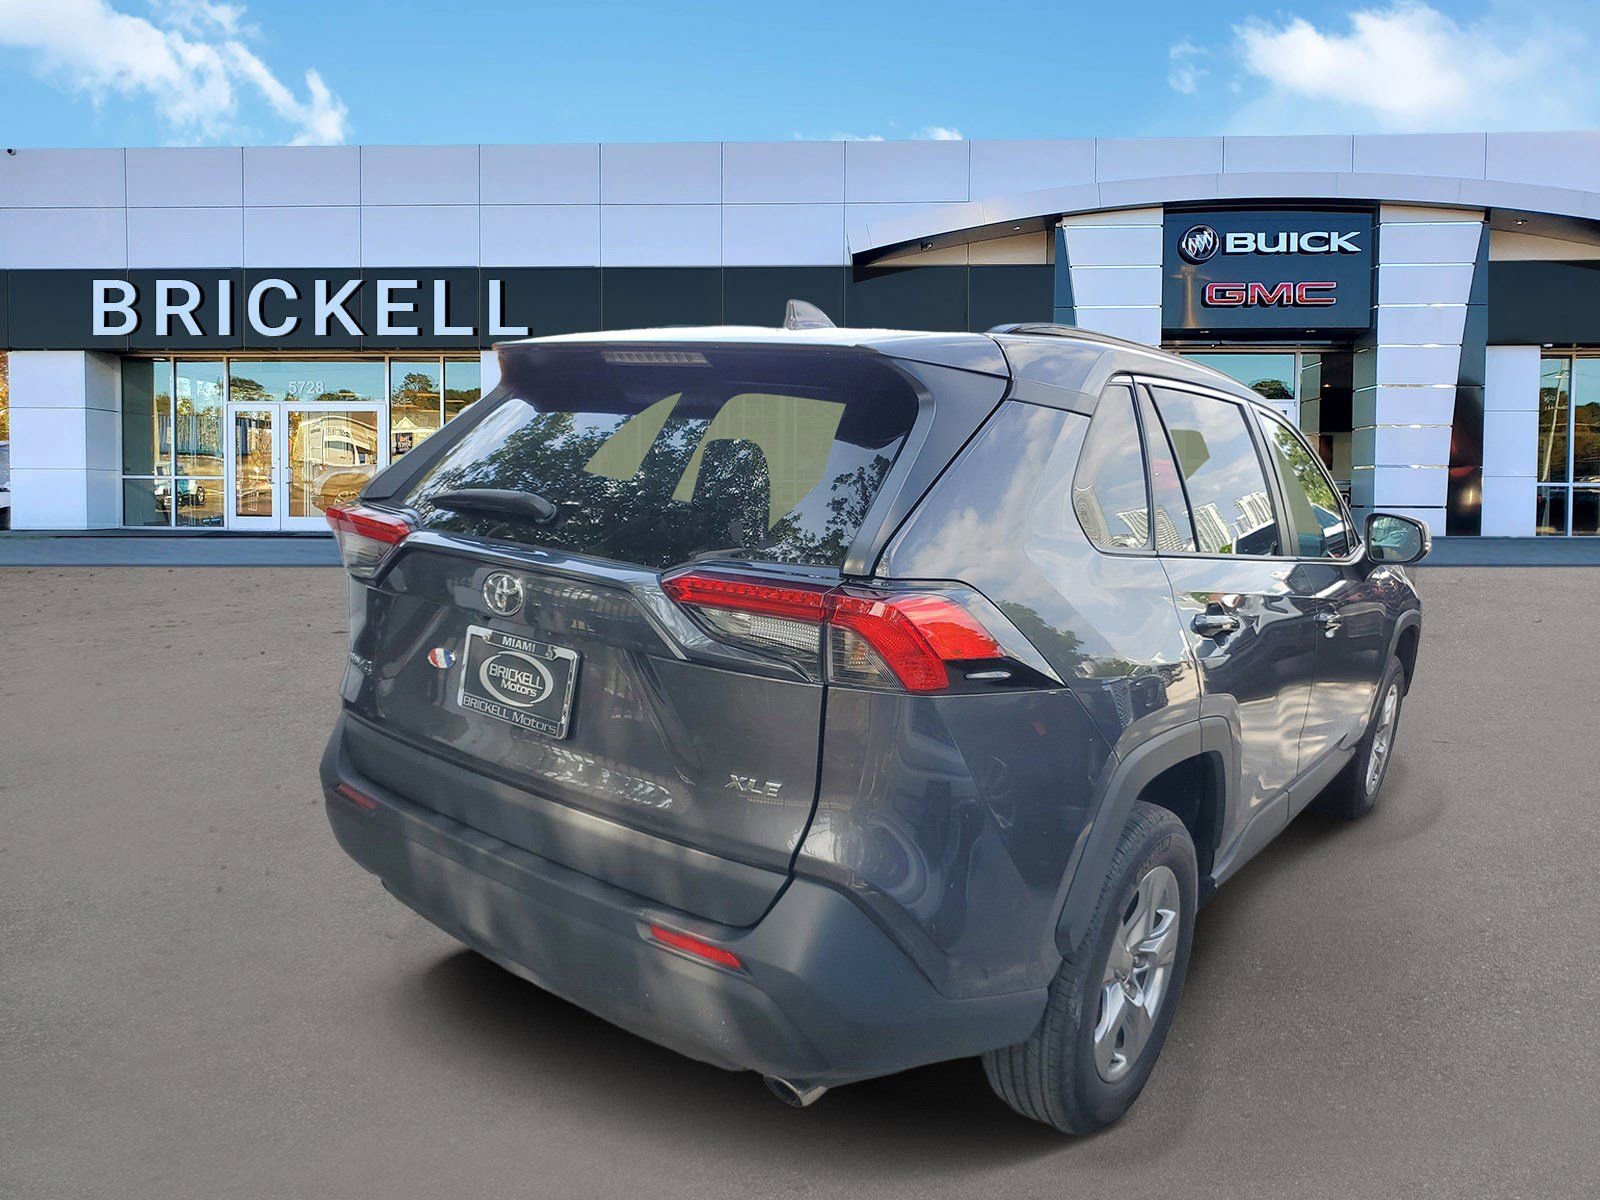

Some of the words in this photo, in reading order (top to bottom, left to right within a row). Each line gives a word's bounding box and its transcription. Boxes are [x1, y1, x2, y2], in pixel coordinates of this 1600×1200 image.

[1225, 231, 1362, 253] BUICK
[1205, 281, 1337, 305] GMC
[91, 278, 531, 337] BRICKELL
[288, 381, 325, 394] 5728
[501, 635, 536, 653] MIAMI
[488, 663, 543, 690] BRICKELL
[500, 678, 538, 698] Motors
[463, 695, 511, 720] BRICKELL
[512, 710, 558, 735] Motors
[724, 774, 783, 797] XLE
